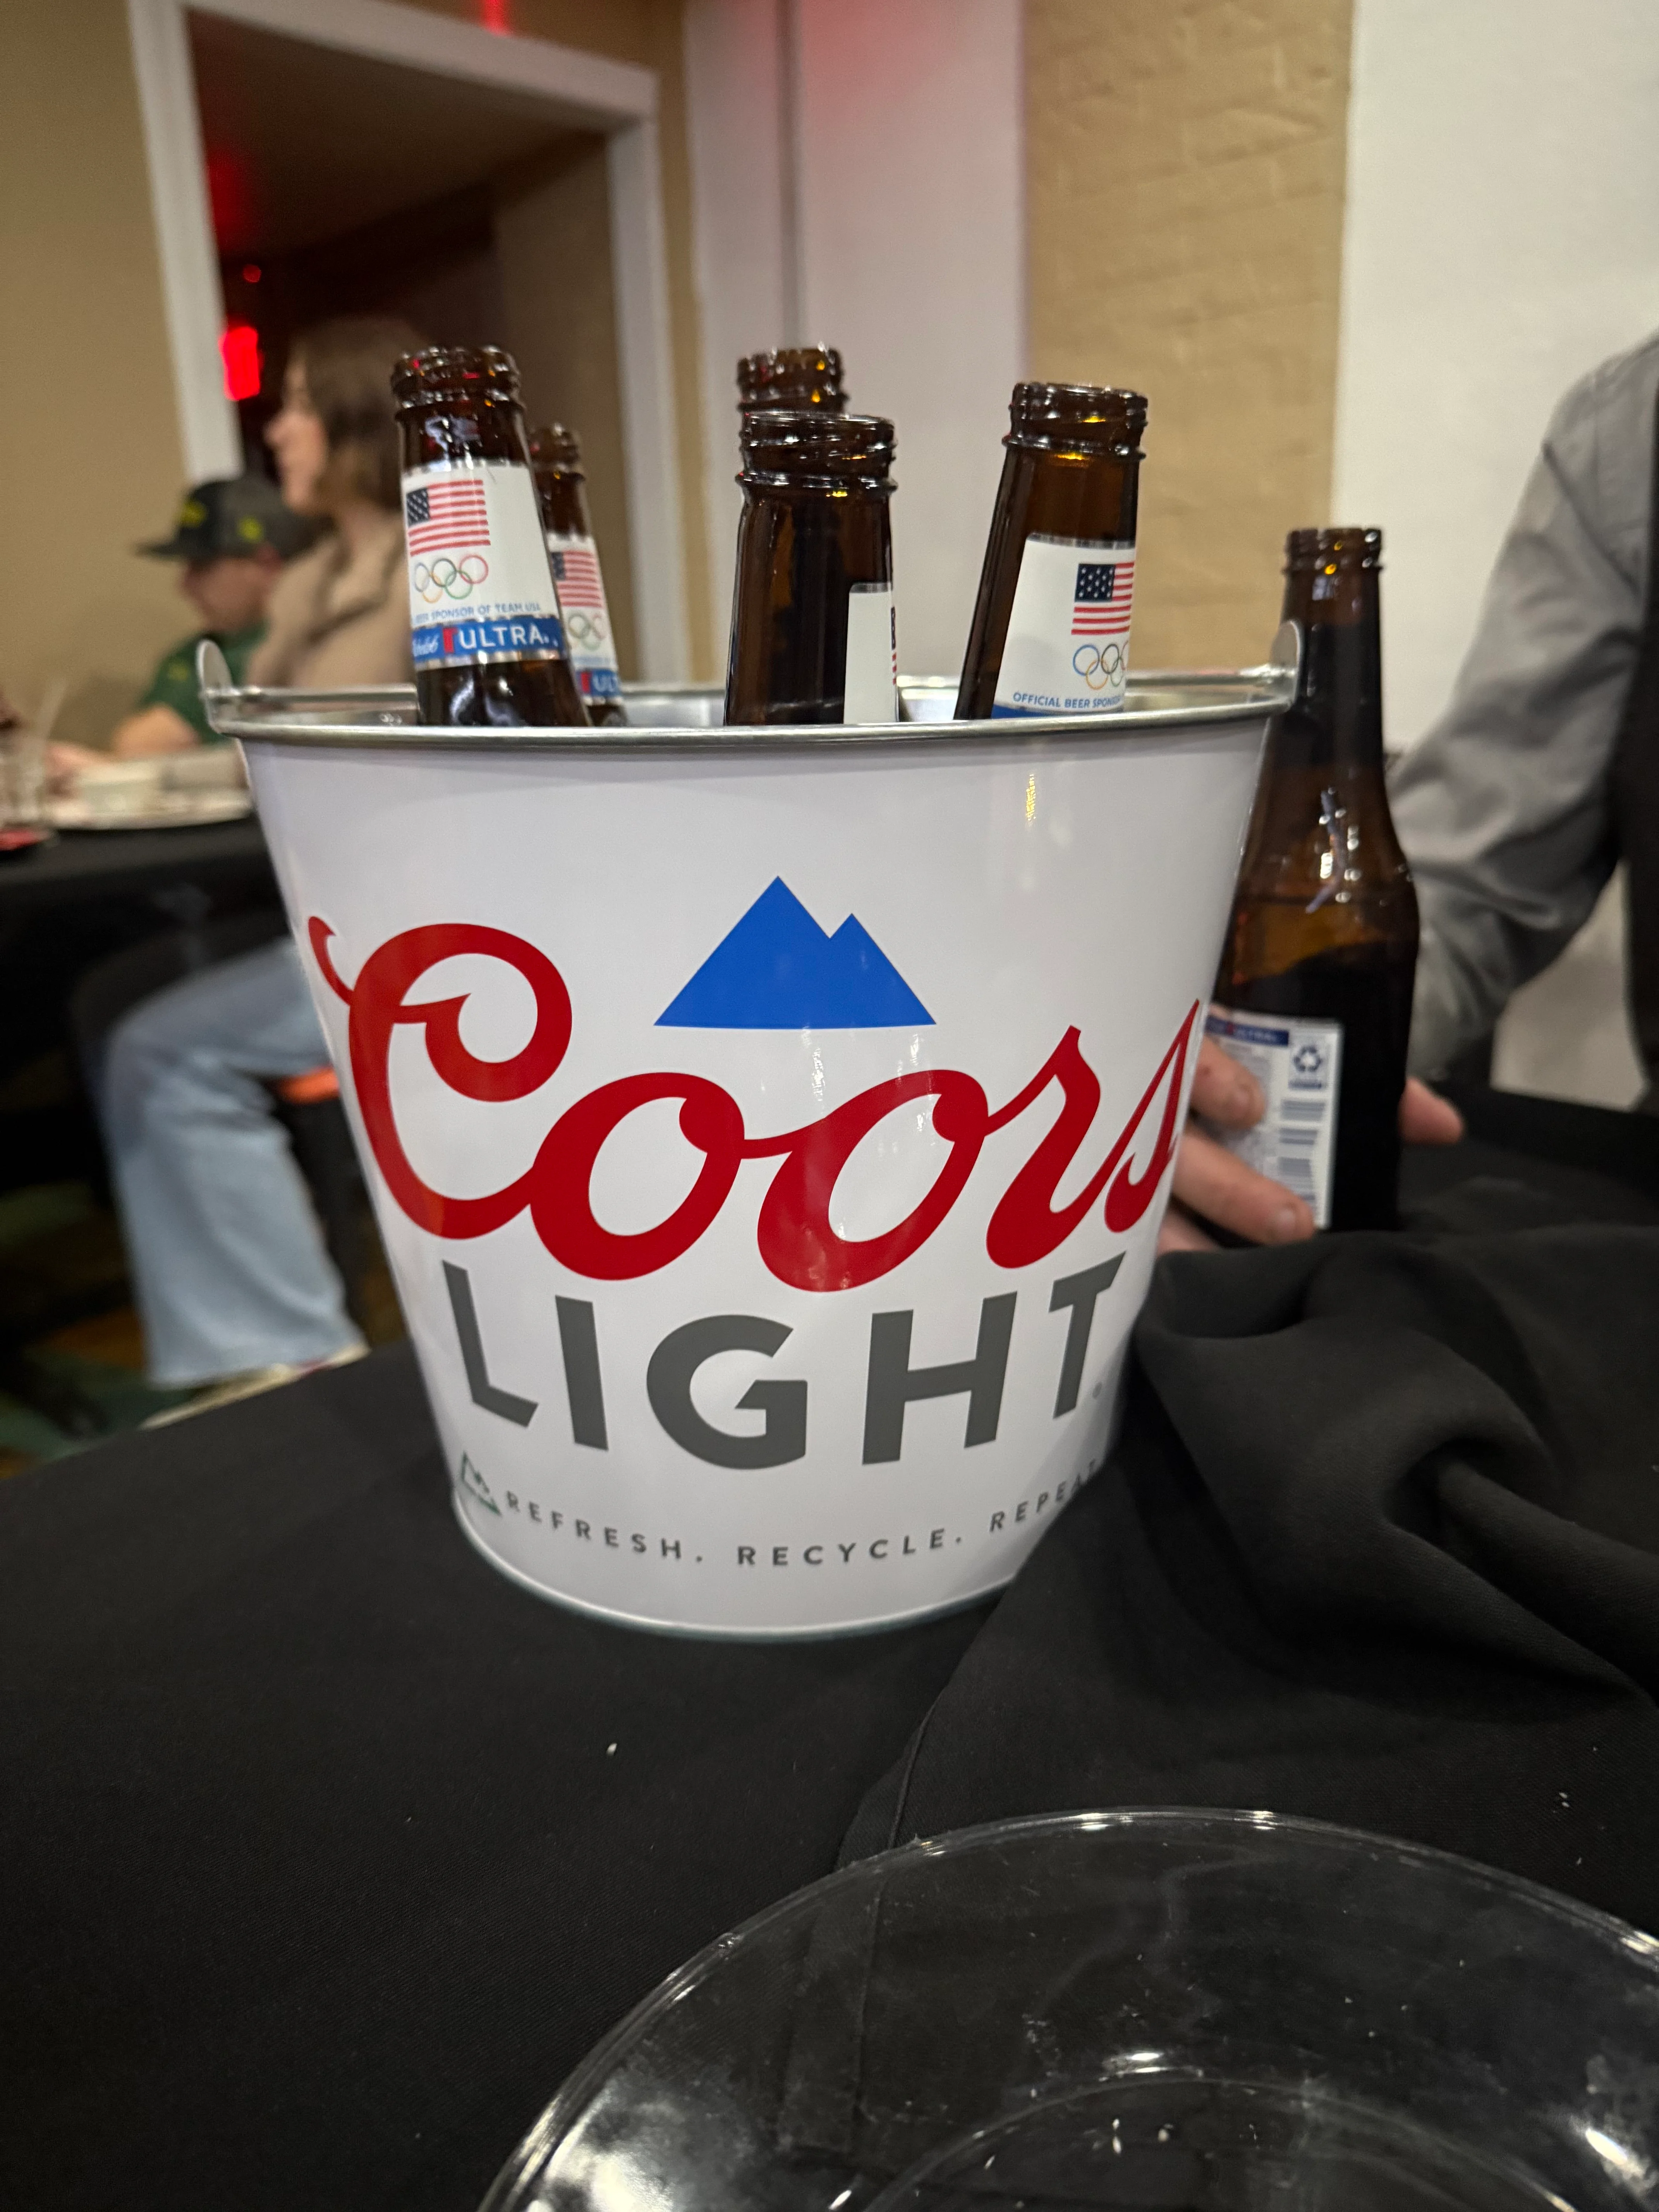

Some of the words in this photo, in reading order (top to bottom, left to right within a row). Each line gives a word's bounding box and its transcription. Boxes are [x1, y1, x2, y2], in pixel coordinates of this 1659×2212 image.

[477, 603, 491, 615] OF
[495, 602, 523, 613] TEAM
[1013, 692, 1061, 708] OFFICIAL
[1065, 698, 1090, 709] BEER
[307, 916, 1199, 1292] Coors
[443, 1250, 1127, 1469] LIGHT
[506, 1490, 702, 1562] REFRESH.
[737, 1528, 962, 1566] RECYCLE.
